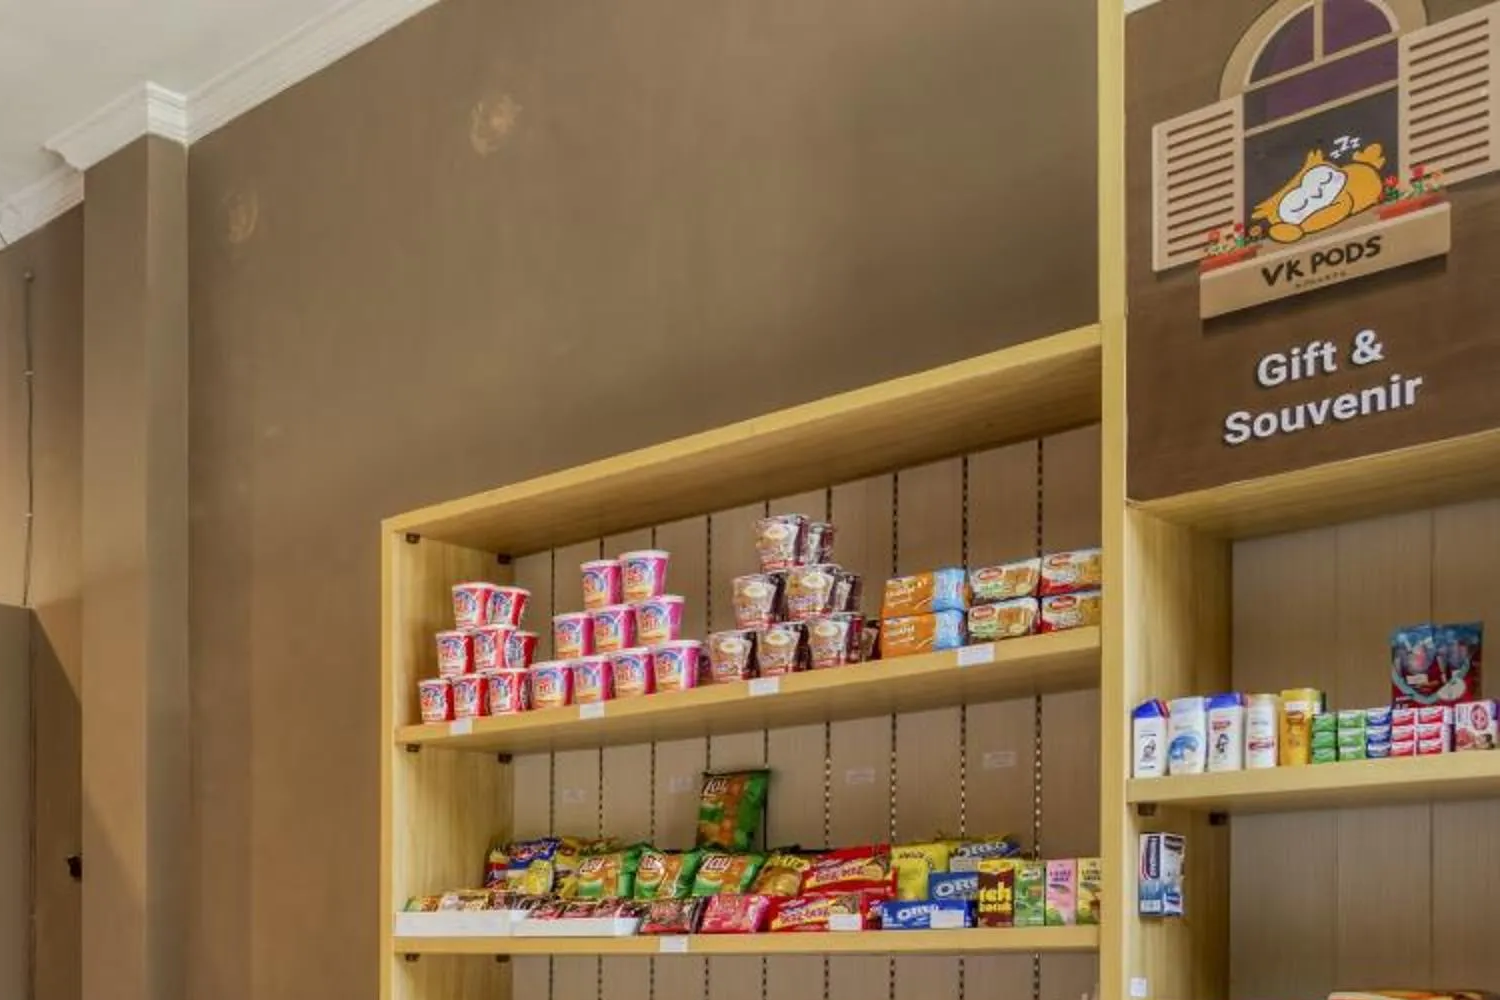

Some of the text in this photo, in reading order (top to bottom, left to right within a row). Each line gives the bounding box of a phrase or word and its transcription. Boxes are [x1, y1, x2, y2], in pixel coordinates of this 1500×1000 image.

[1261, 258, 1304, 287] VK
[1310, 235, 1383, 274] PODS
[1257, 329, 1385, 388] Gift &
[1223, 375, 1424, 446] Souvenir
